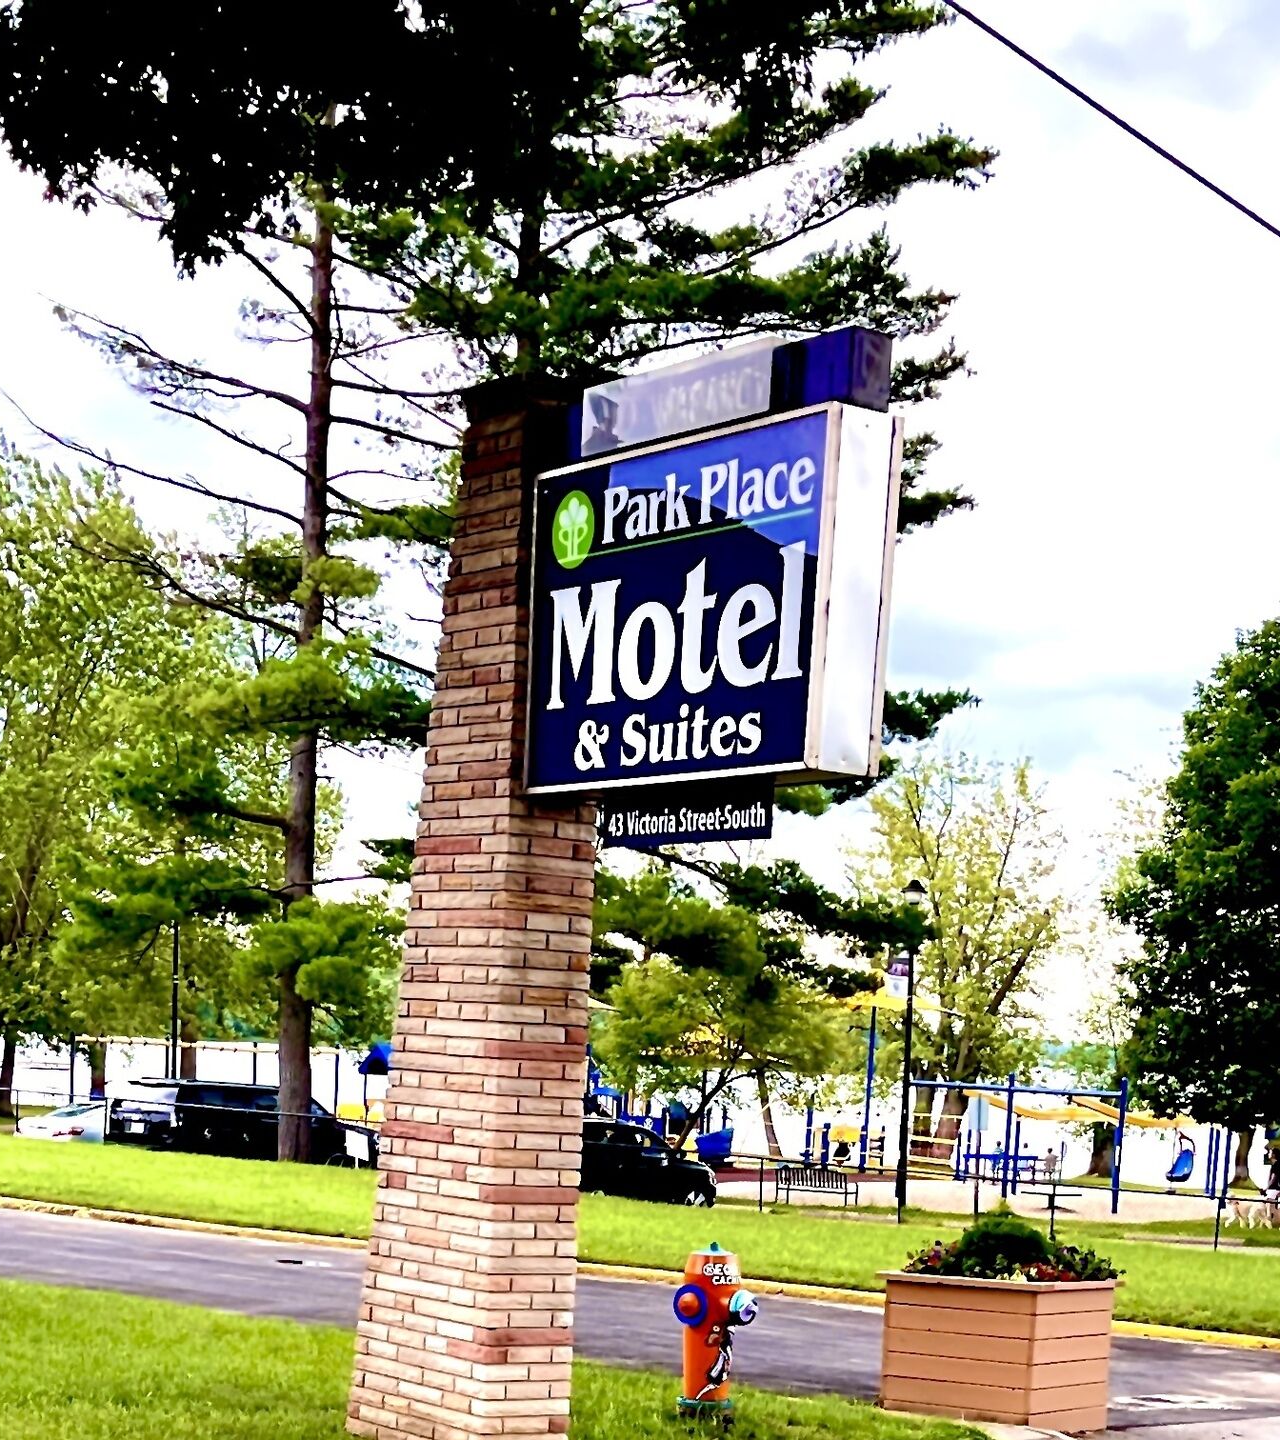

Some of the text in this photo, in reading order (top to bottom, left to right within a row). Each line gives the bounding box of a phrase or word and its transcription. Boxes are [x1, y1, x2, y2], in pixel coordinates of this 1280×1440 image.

[601, 454, 816, 545] Park Place
[546, 540, 807, 711] Motel
[573, 703, 762, 772] & Suites
[608, 812, 624, 837] 43
[627, 808, 676, 836] Victoria
